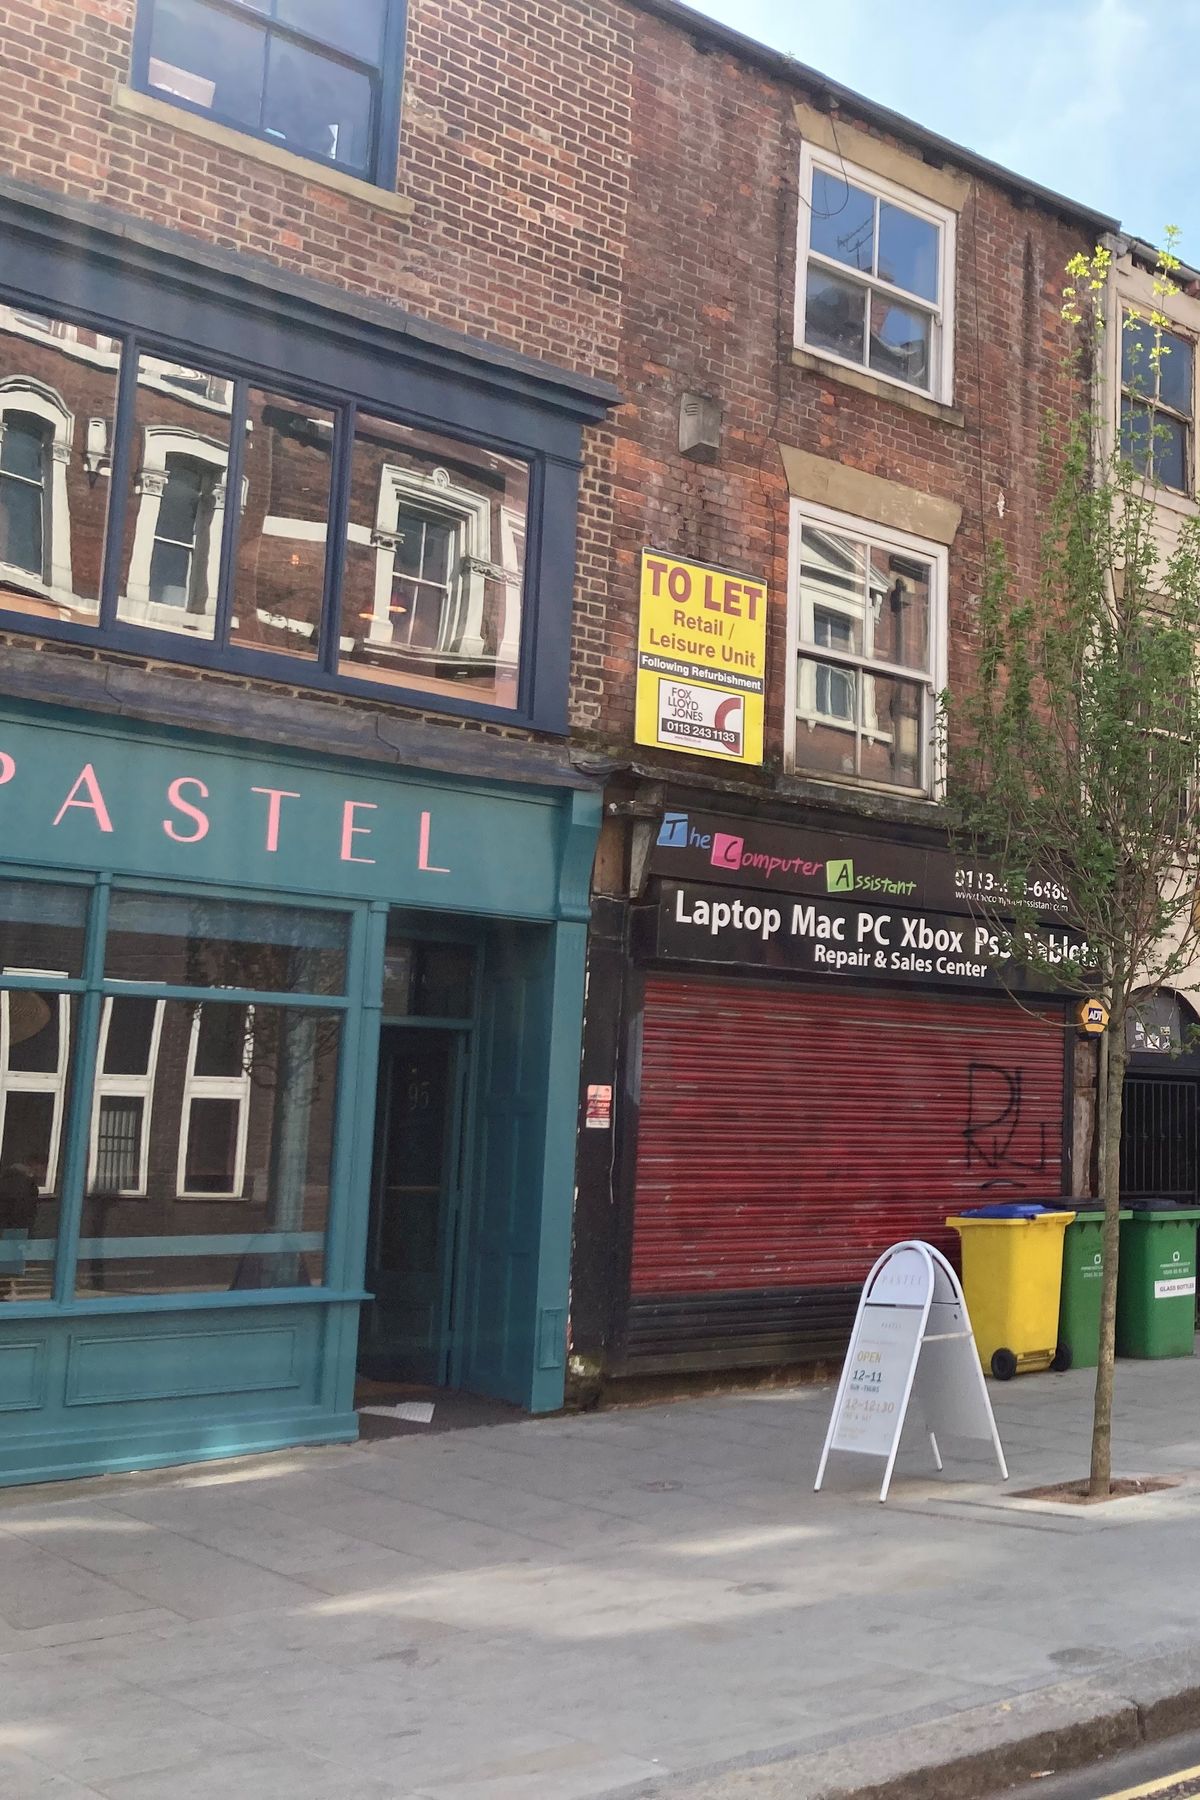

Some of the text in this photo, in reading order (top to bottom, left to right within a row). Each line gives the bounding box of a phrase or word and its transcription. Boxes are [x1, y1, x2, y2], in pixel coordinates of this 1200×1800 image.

[646, 560, 764, 621] TO LET
[673, 609, 724, 637] Retail
[649, 628, 756, 669] Leisure Unit
[641, 655, 762, 690] Following Refurbishment
[668, 695, 699, 711] LLOYD
[671, 687, 692, 700] FOX
[671, 708, 703, 722] JONES
[667, 721, 690, 734] 0113
[692, 726, 712, 738] 243
[713, 730, 736, 743] 1133
[661, 816, 918, 896] The Computer Assistant
[675, 890, 781, 940] Laptop
[791, 904, 845, 940] Mac
[857, 912, 891, 945] PC
[900, 917, 963, 953] Xbox
[814, 944, 987, 978] Repair & Sales Center
[1088, 1010, 1103, 1022] ADT
[857, 1350, 882, 1364] OPEN
[852, 1369, 882, 1383] 12-11
